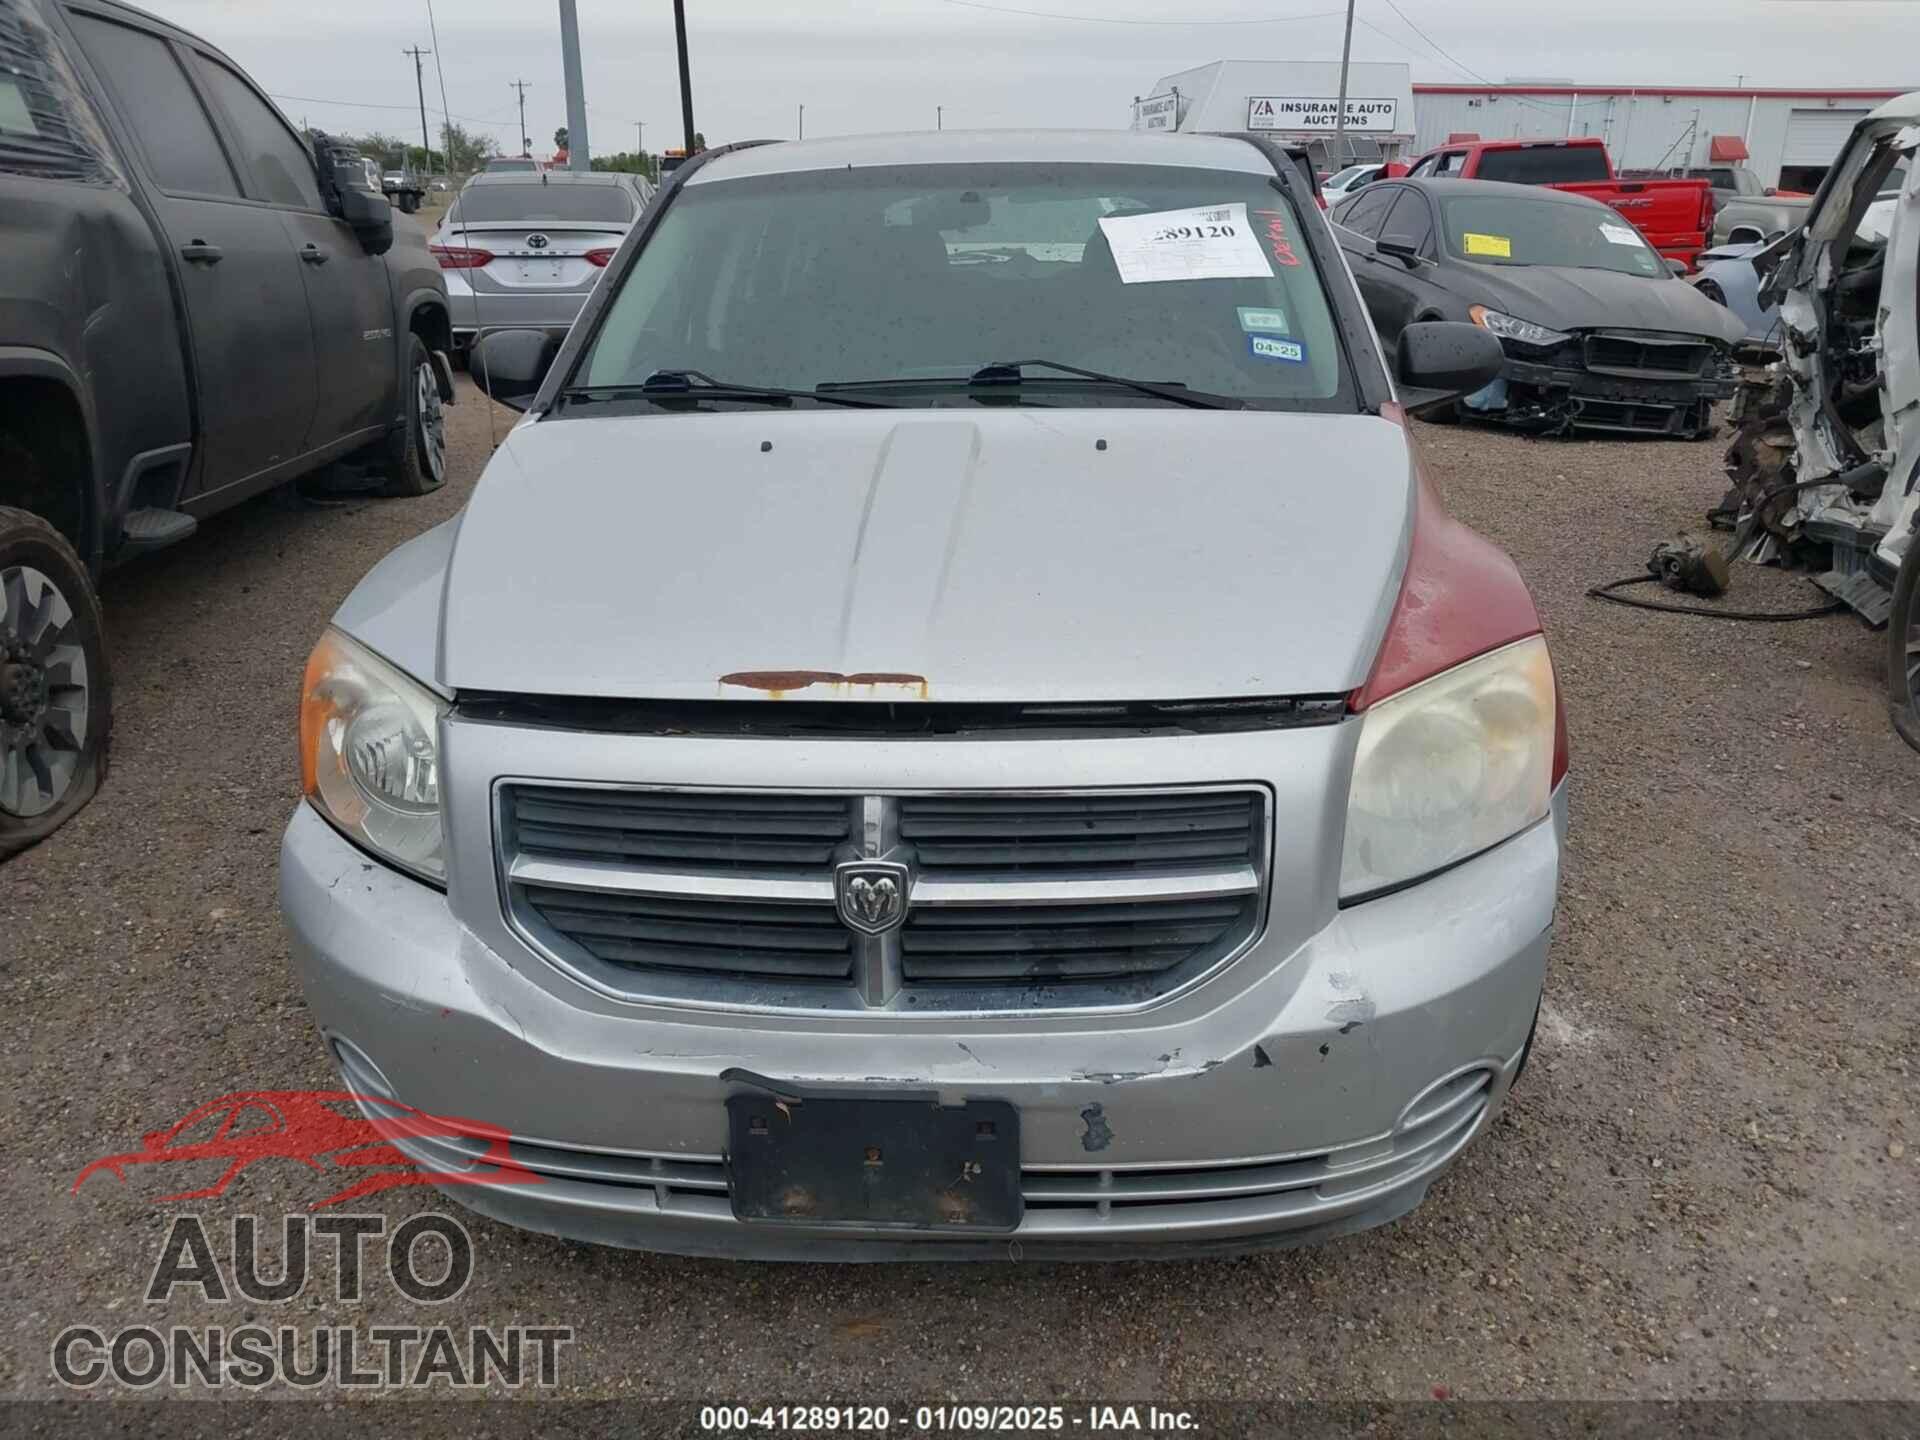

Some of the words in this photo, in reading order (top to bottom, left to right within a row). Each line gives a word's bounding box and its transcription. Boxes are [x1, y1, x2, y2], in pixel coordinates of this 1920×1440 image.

[1280, 103, 1353, 113] INSURANE
[1358, 104, 1392, 114] AUTO
[1303, 115, 1368, 125] AUCTONS
